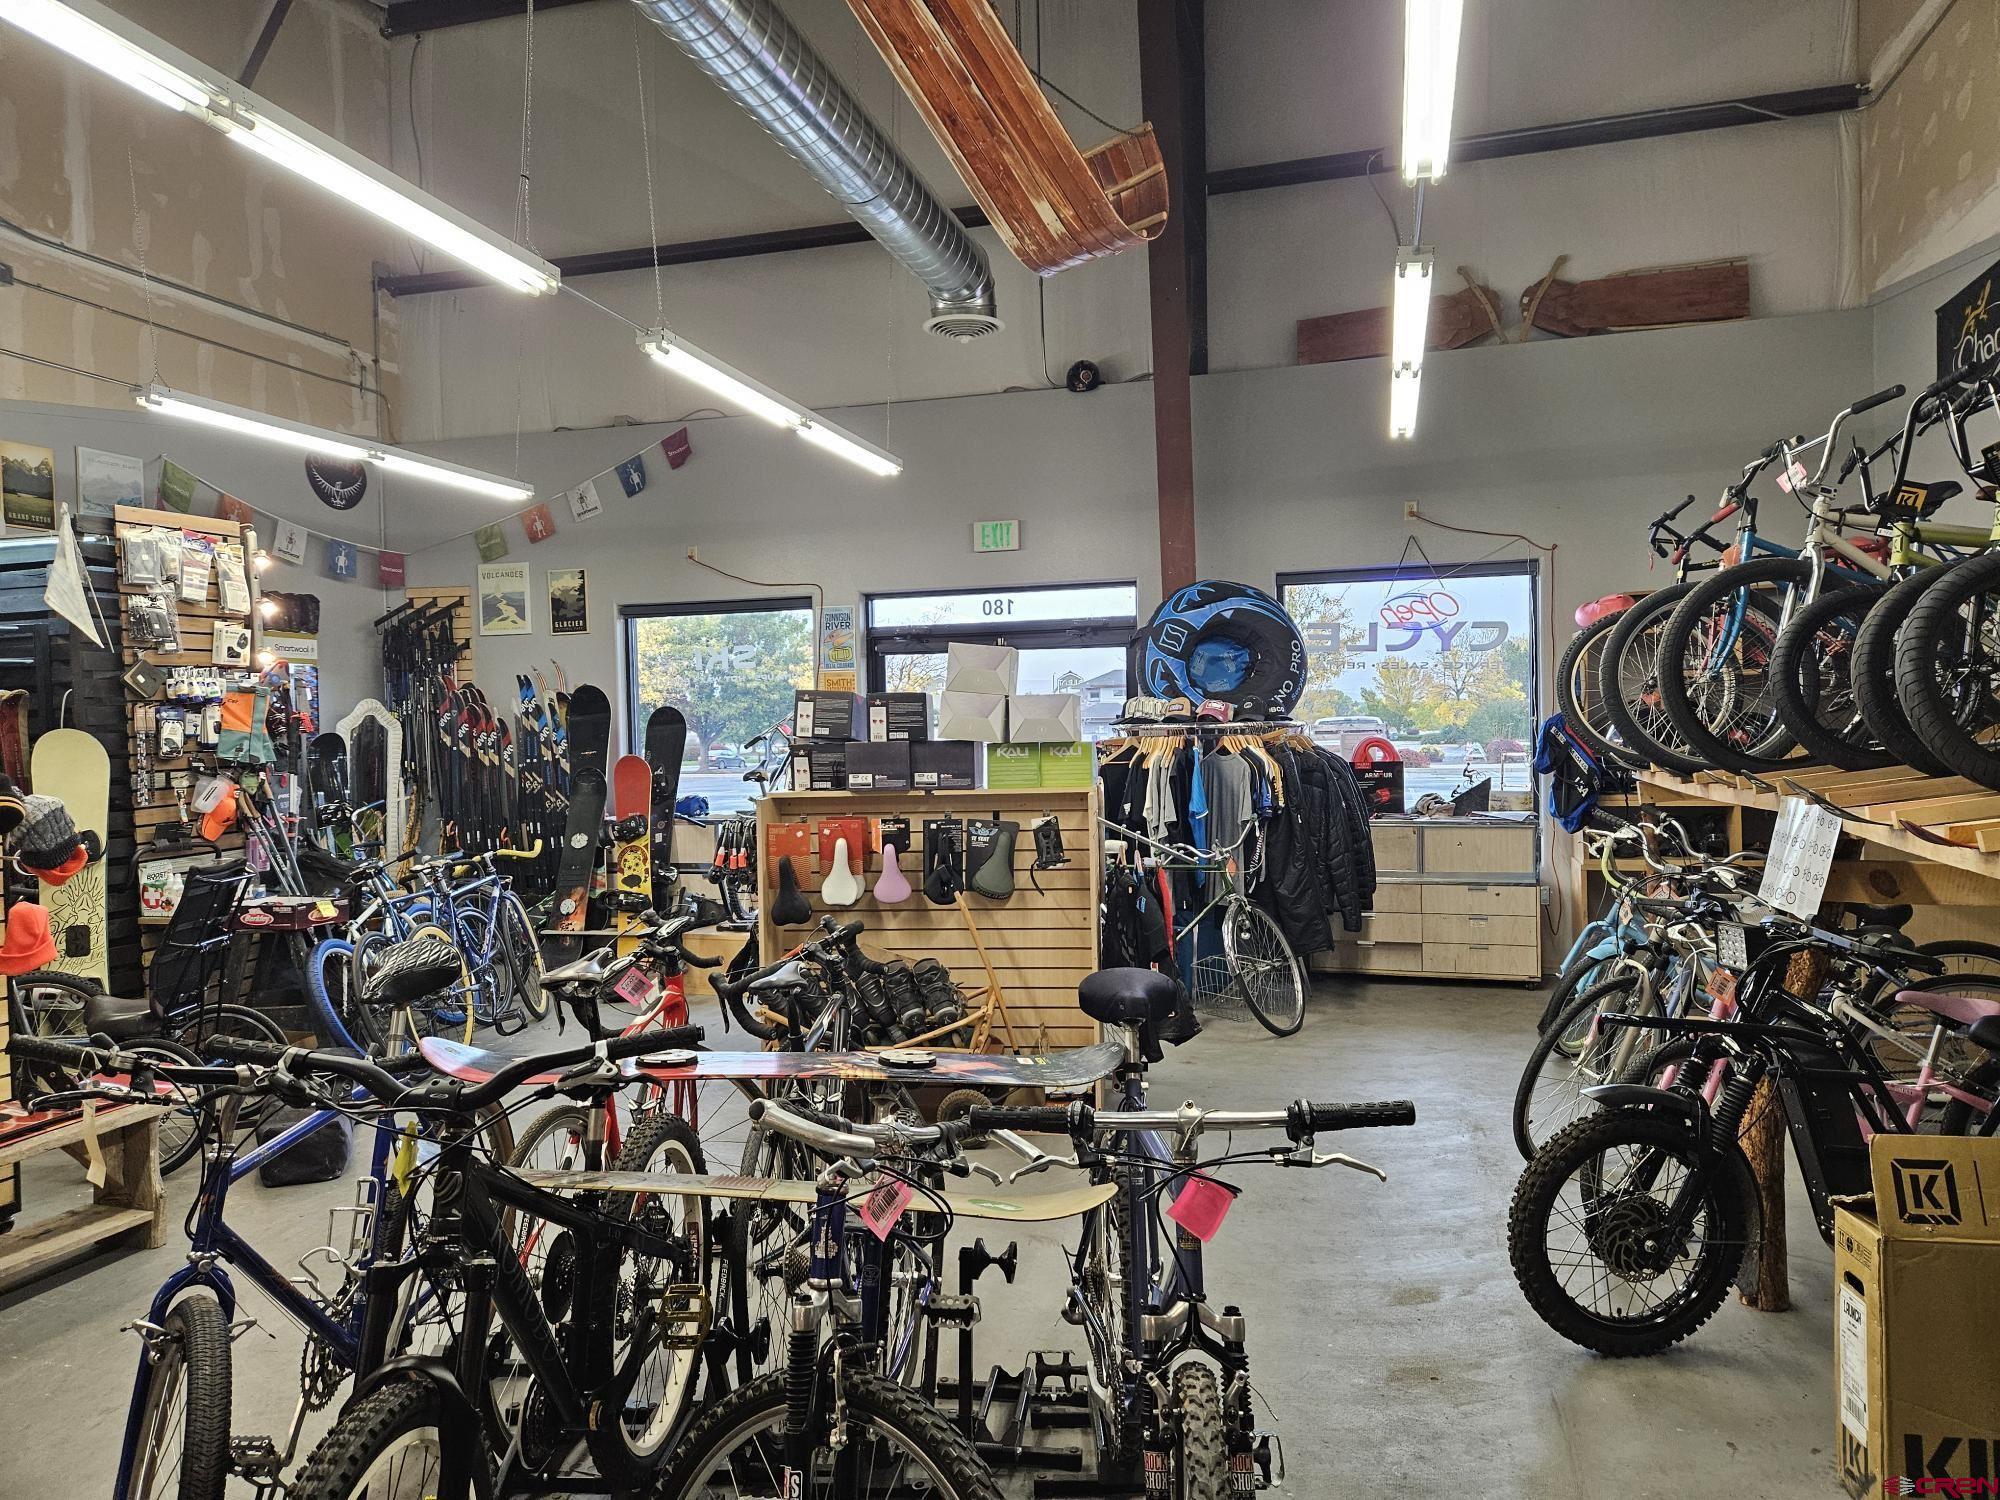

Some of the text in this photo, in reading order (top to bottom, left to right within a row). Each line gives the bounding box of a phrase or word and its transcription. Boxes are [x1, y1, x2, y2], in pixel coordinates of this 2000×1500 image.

[980, 523, 1012, 548] EXIT
[481, 570, 524, 580] VOLCANOES
[554, 620, 584, 628] GLACIER
[824, 613, 851, 622] GUNNISON
[825, 621, 851, 631] RIVER
[274, 643, 310, 653] Smartwool
[1289, 639, 1302, 674] PRO
[826, 678, 852, 687] SMITH
[997, 746, 1029, 759] KALI
[1050, 745, 1082, 758] KALI
[1909, 1174, 1944, 1209] K
[720, 1258, 729, 1299] FEEDBACK
[1844, 1299, 1862, 1327] LAUNCH
[1145, 1452, 1168, 1471] ROCK
[1232, 1454, 1254, 1472] ROCK
[1145, 1471, 1168, 1490] SHOX
